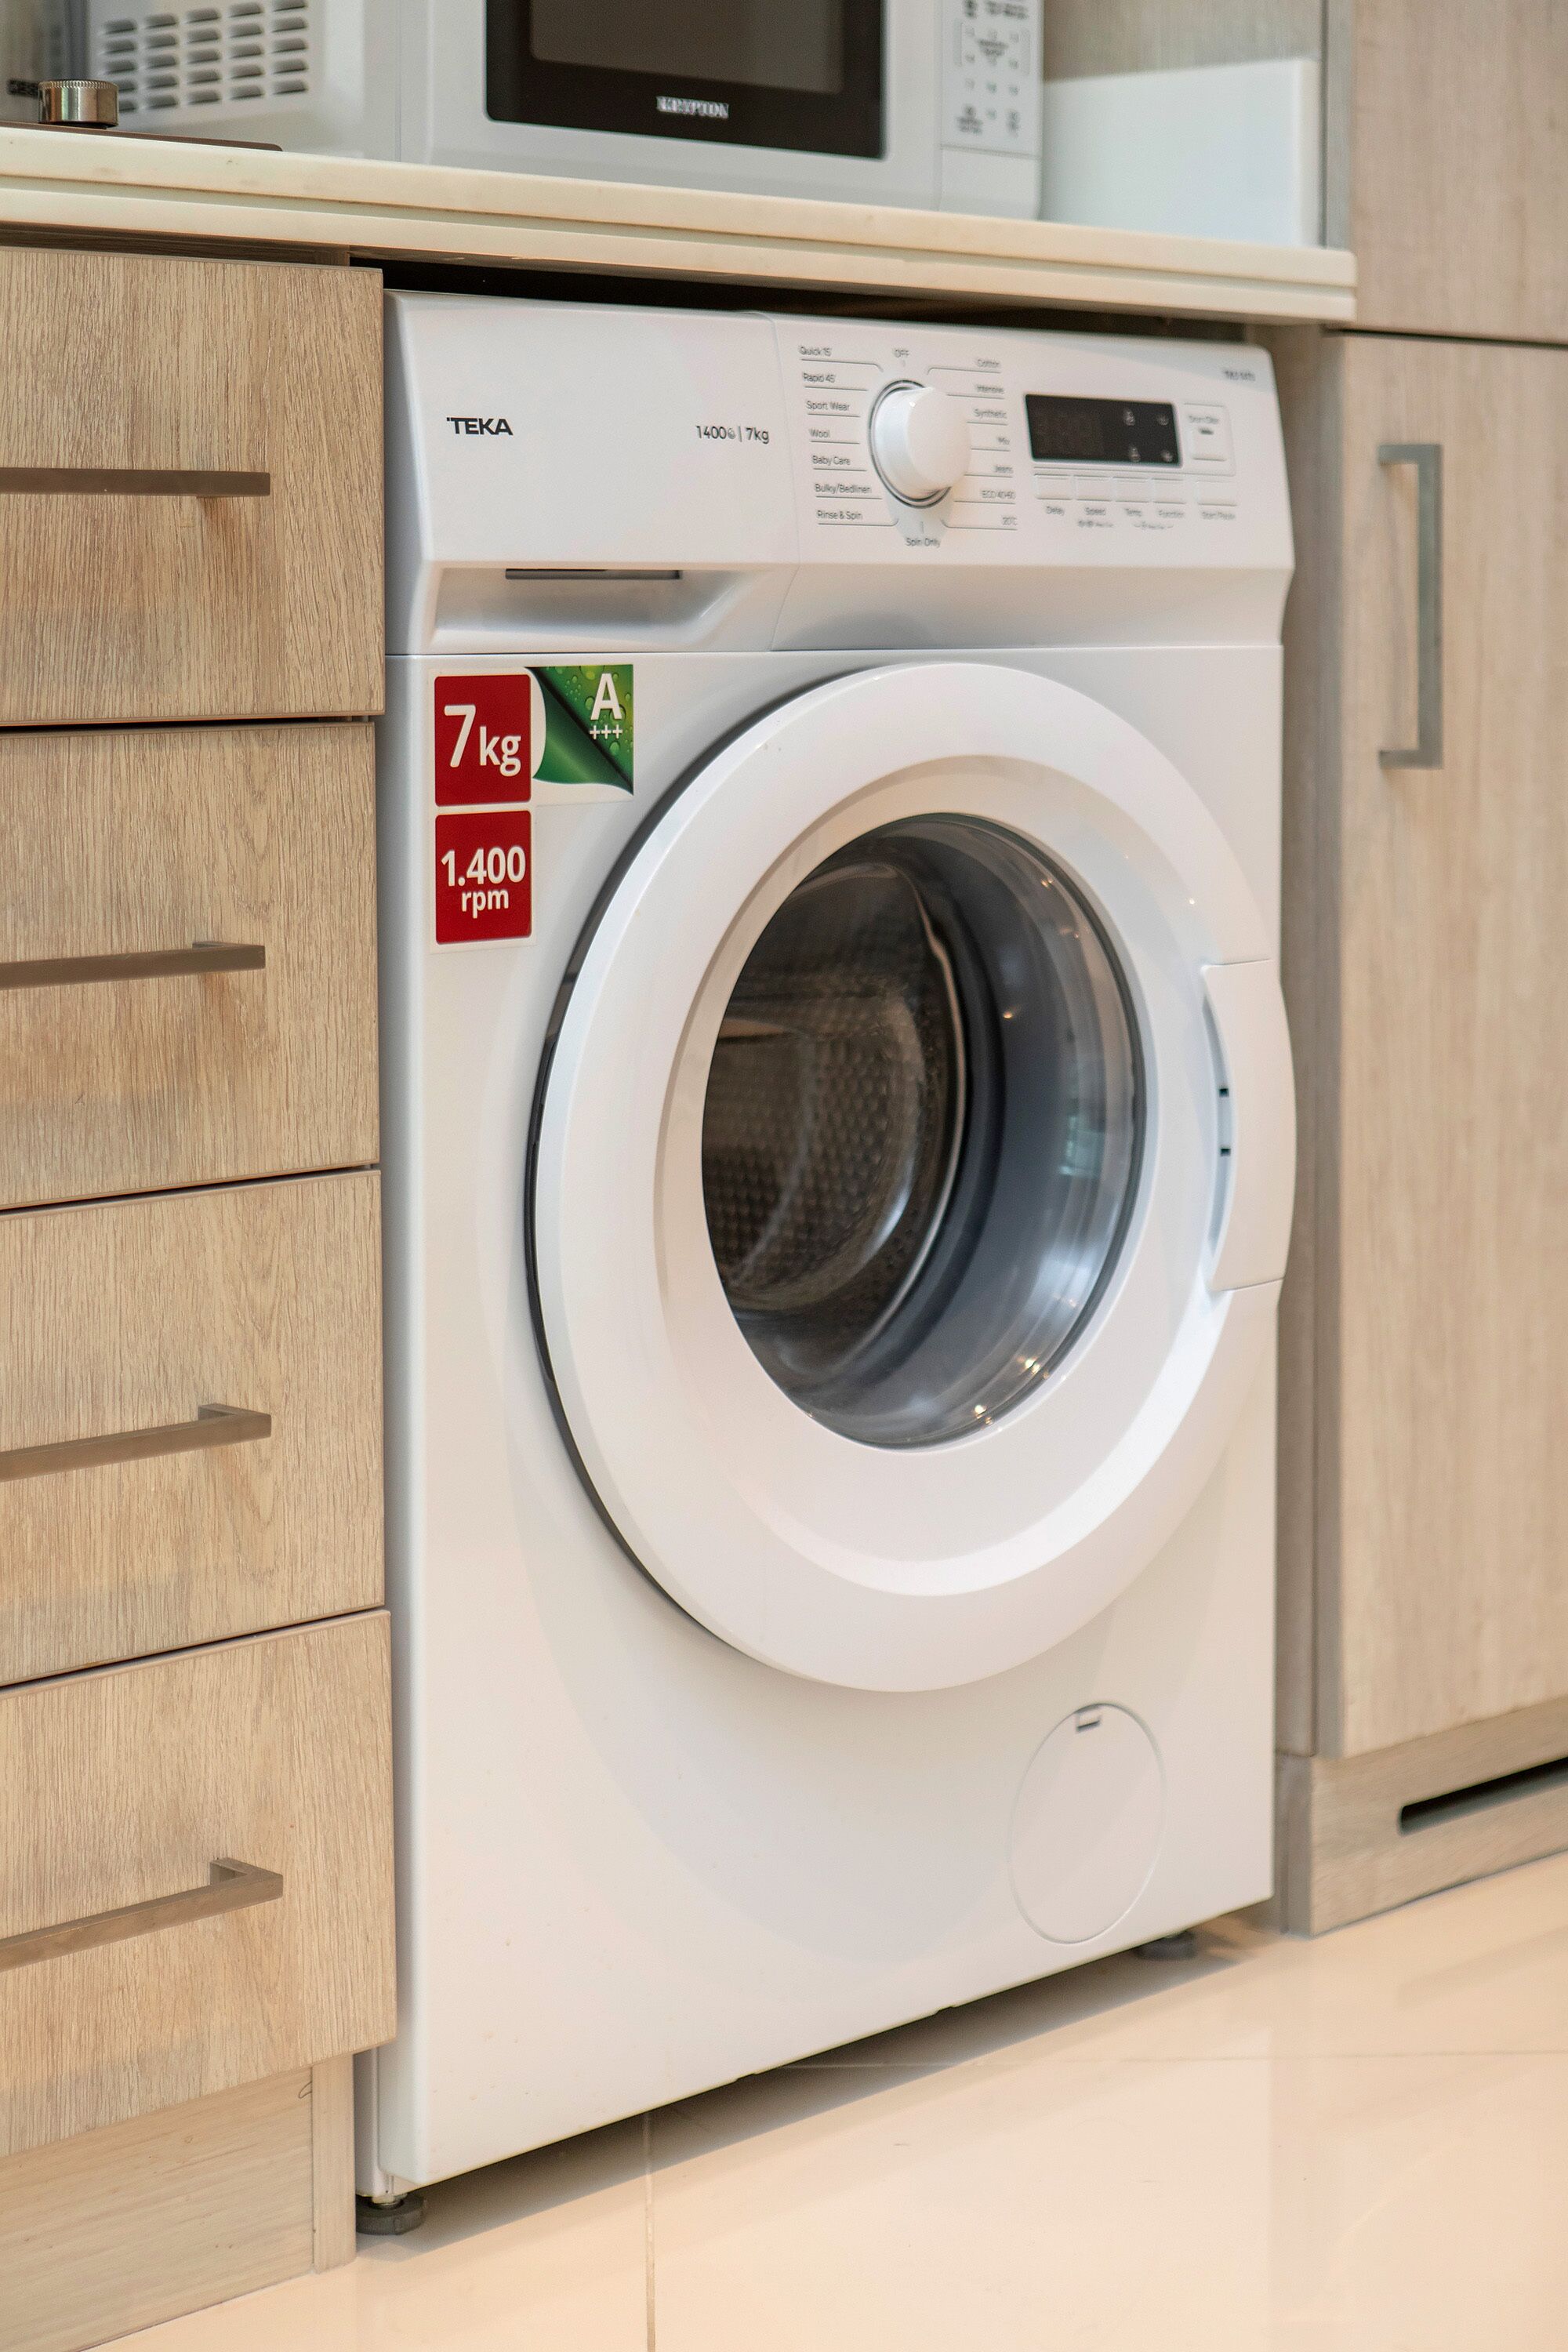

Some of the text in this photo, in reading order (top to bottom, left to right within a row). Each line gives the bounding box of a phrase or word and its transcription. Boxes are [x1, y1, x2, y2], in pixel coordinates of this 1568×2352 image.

[799, 346, 822, 356] Quick
[894, 349, 909, 358] OFF
[803, 372, 825, 383] Rapid
[807, 400, 850, 411] Sport Wear
[974, 408, 1007, 419] Synthetic
[446, 417, 514, 436] TEKA
[695, 426, 769, 445] 1400 7kg
[809, 429, 830, 438] Wool
[812, 455, 851, 465] Baby Care
[815, 483, 872, 494] Bulky/Bedlinen
[817, 510, 838, 519] Rinse
[846, 510, 862, 521] Spin
[906, 537, 940, 548] Spin Only
[590, 673, 622, 720] A
[441, 846, 526, 887] 1.400
[461, 888, 509, 919] rpm
